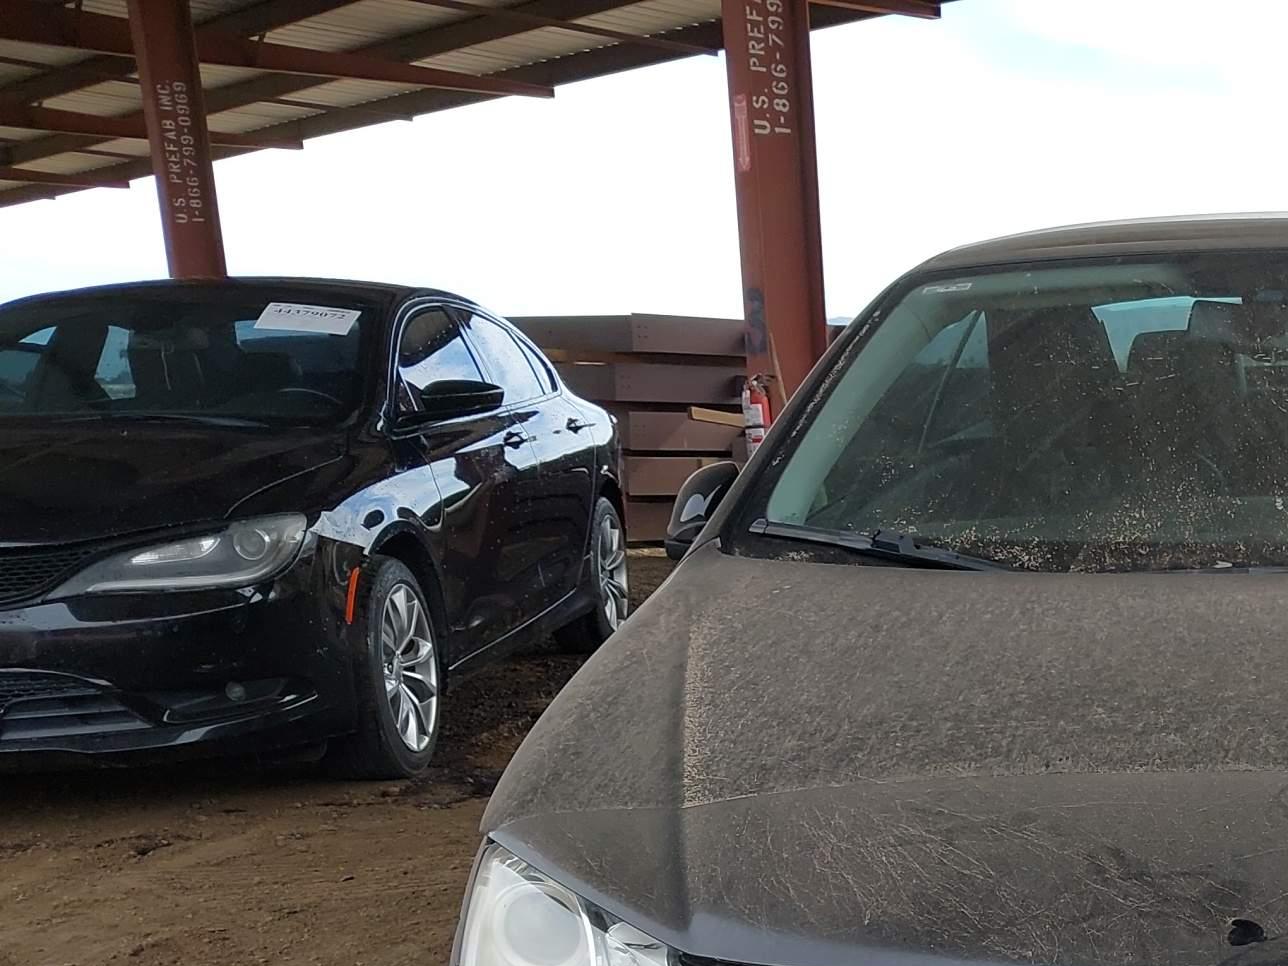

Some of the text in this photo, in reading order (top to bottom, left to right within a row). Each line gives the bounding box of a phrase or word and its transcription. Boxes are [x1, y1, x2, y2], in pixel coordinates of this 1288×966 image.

[156, 79, 174, 111] INC.
[746, 0, 771, 135] U.S. PREF
[161, 119, 183, 183] PREFAB
[172, 81, 205, 223] 1-866-799-0969
